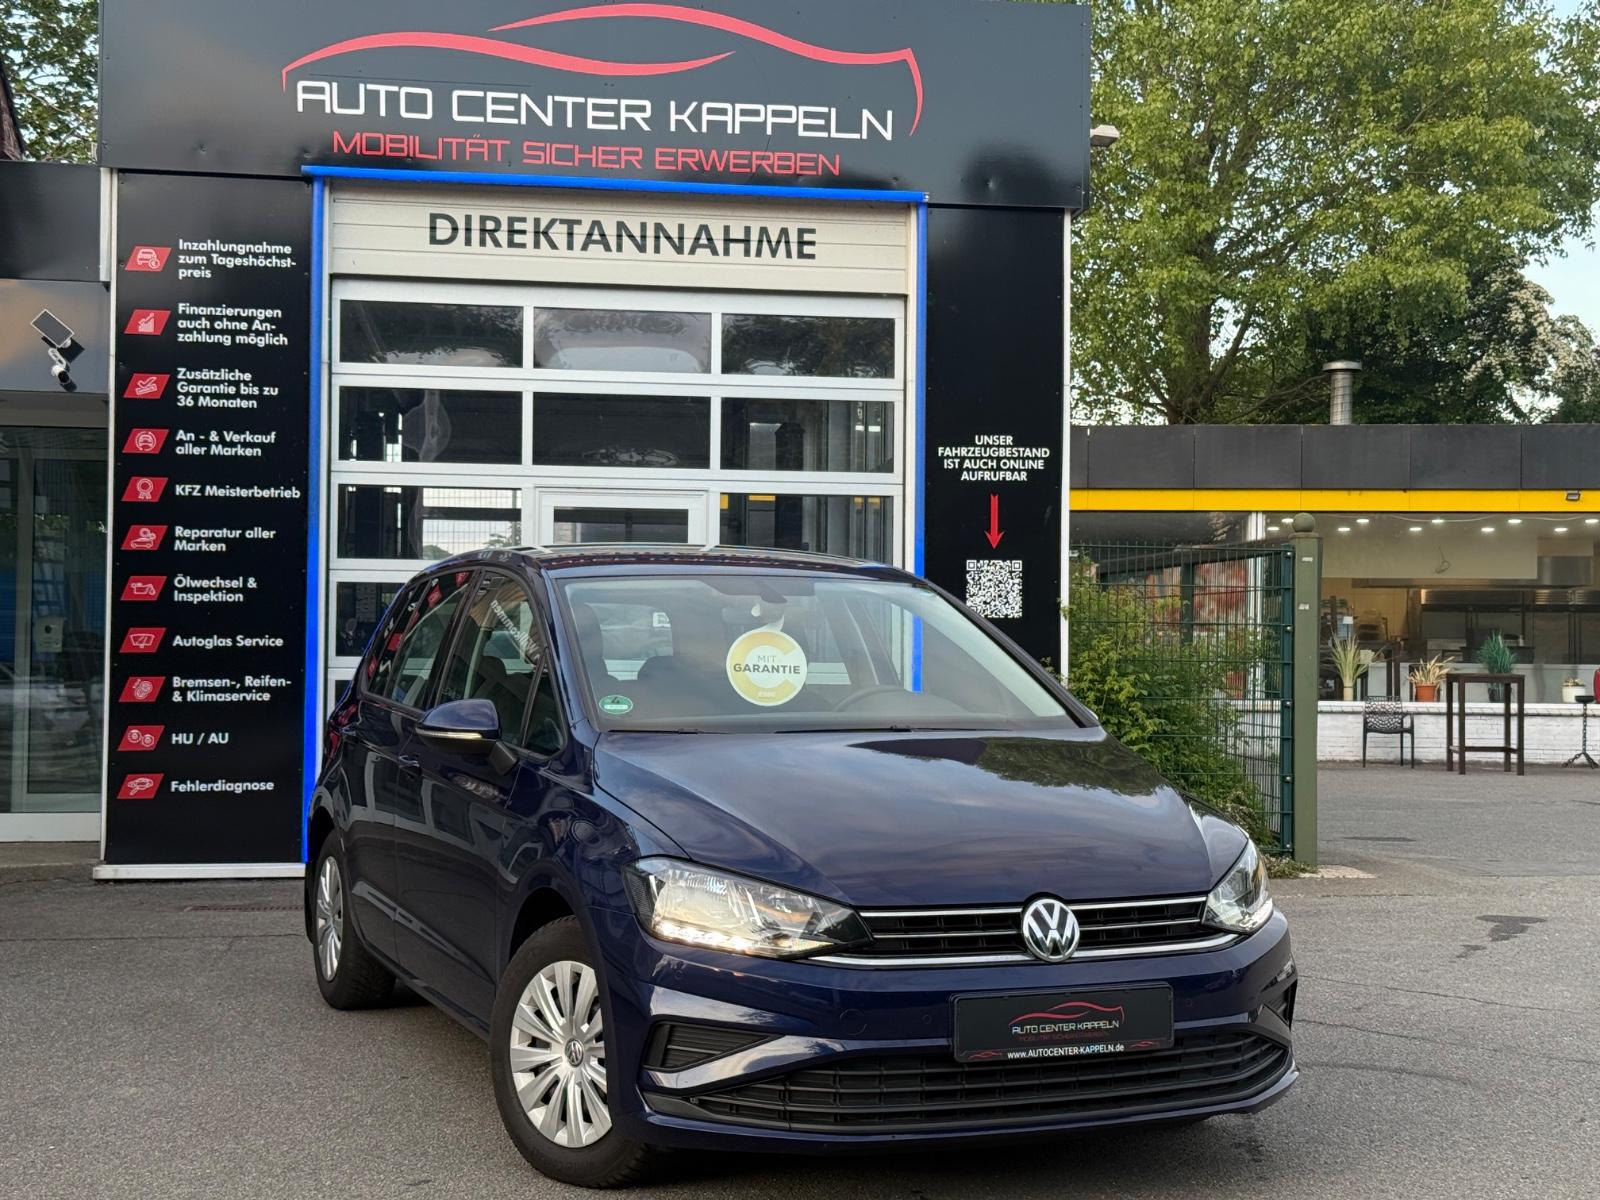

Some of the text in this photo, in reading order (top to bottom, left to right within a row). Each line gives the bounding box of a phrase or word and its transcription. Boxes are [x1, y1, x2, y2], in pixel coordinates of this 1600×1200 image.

[296, 80, 893, 142] AUTO CENTER KAPPELN
[333, 130, 841, 176] MOBILITÄT SICHER ERWERBEN
[428, 212, 817, 260] DIREKTANNAHME
[178, 239, 292, 255] Inzahlungnahme
[178, 253, 297, 269] zum Tageshöchst-
[178, 267, 212, 280] preis
[177, 303, 282, 320] Finanzierungen
[177, 318, 276, 331] auch ohne An-
[177, 332, 288, 347] zahlung möglich
[177, 367, 252, 381] Zusätzliche
[177, 382, 279, 395] Garantie bis zu
[177, 396, 258, 409] 36 Monaten
[175, 430, 195, 442] An
[209, 430, 220, 442] &
[223, 430, 277, 444] Verkauf
[974, 435, 1013, 445] UNSER
[175, 443, 262, 457] aller Marken
[938, 446, 1050, 458] FAHRZEUGBESTAND
[943, 459, 1045, 470] IST AUCH ONLINE
[960, 471, 1028, 481] AUFRUFBAR
[175, 484, 301, 499] KFZ Meisterbetrieb
[174, 525, 277, 540] Reparatur aller
[173, 540, 227, 552] Marken
[173, 573, 258, 589] Ölwechsel &
[173, 591, 244, 605] Inspektion
[172, 635, 284, 650] Autoglas Service
[733, 663, 800, 674] GARANTIE
[172, 675, 292, 689] Bremsen-, Reifen-
[172, 690, 271, 703] & Klimaservice
[171, 733, 194, 745] HU
[207, 732, 230, 745] AU
[170, 779, 275, 794] Fehlerdiagnose
[1012, 1019, 1120, 1036] AUTO CENTER KAPPELN
[1007, 1044, 1125, 1059] www.AUTOCENTER-KAPPELN.de
